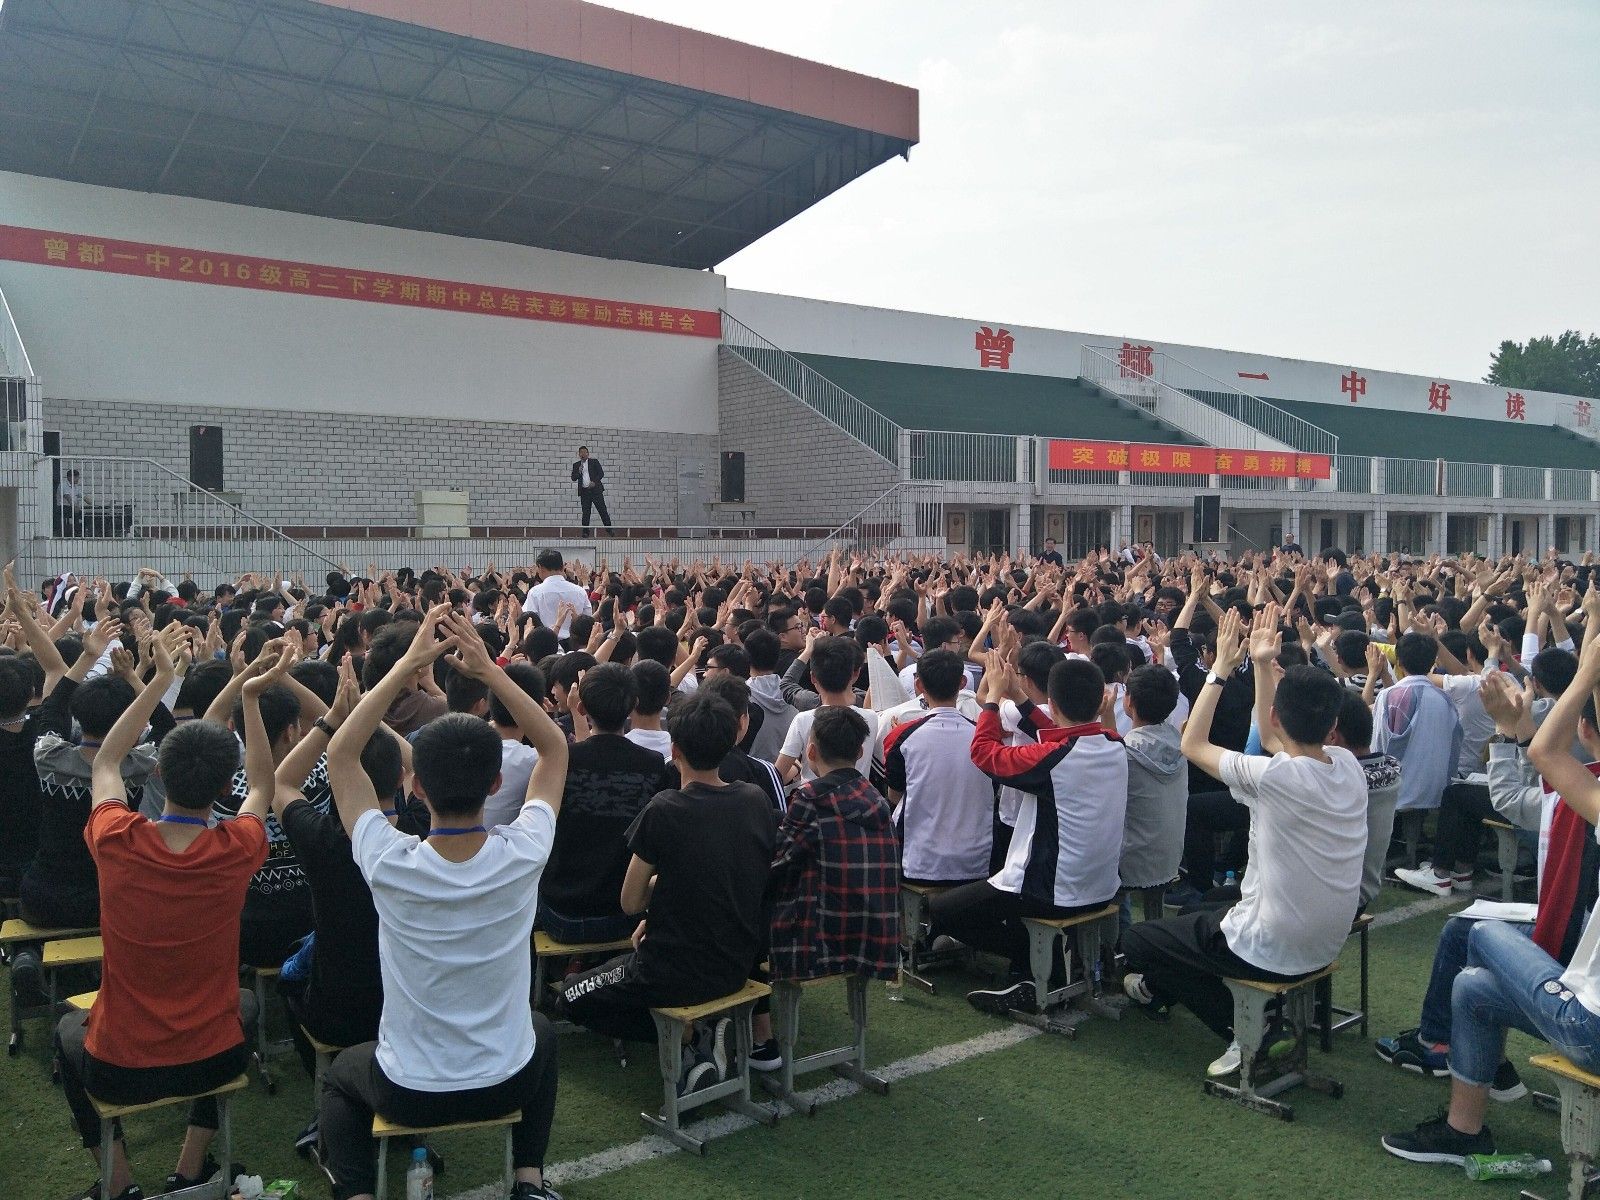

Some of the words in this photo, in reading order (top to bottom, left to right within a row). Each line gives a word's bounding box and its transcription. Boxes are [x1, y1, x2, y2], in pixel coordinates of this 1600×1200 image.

[1072, 447, 1192, 468] 突破极限
[1216, 453, 1312, 473] 奋勇拼搏
[565, 977, 596, 1002] PLAYER
